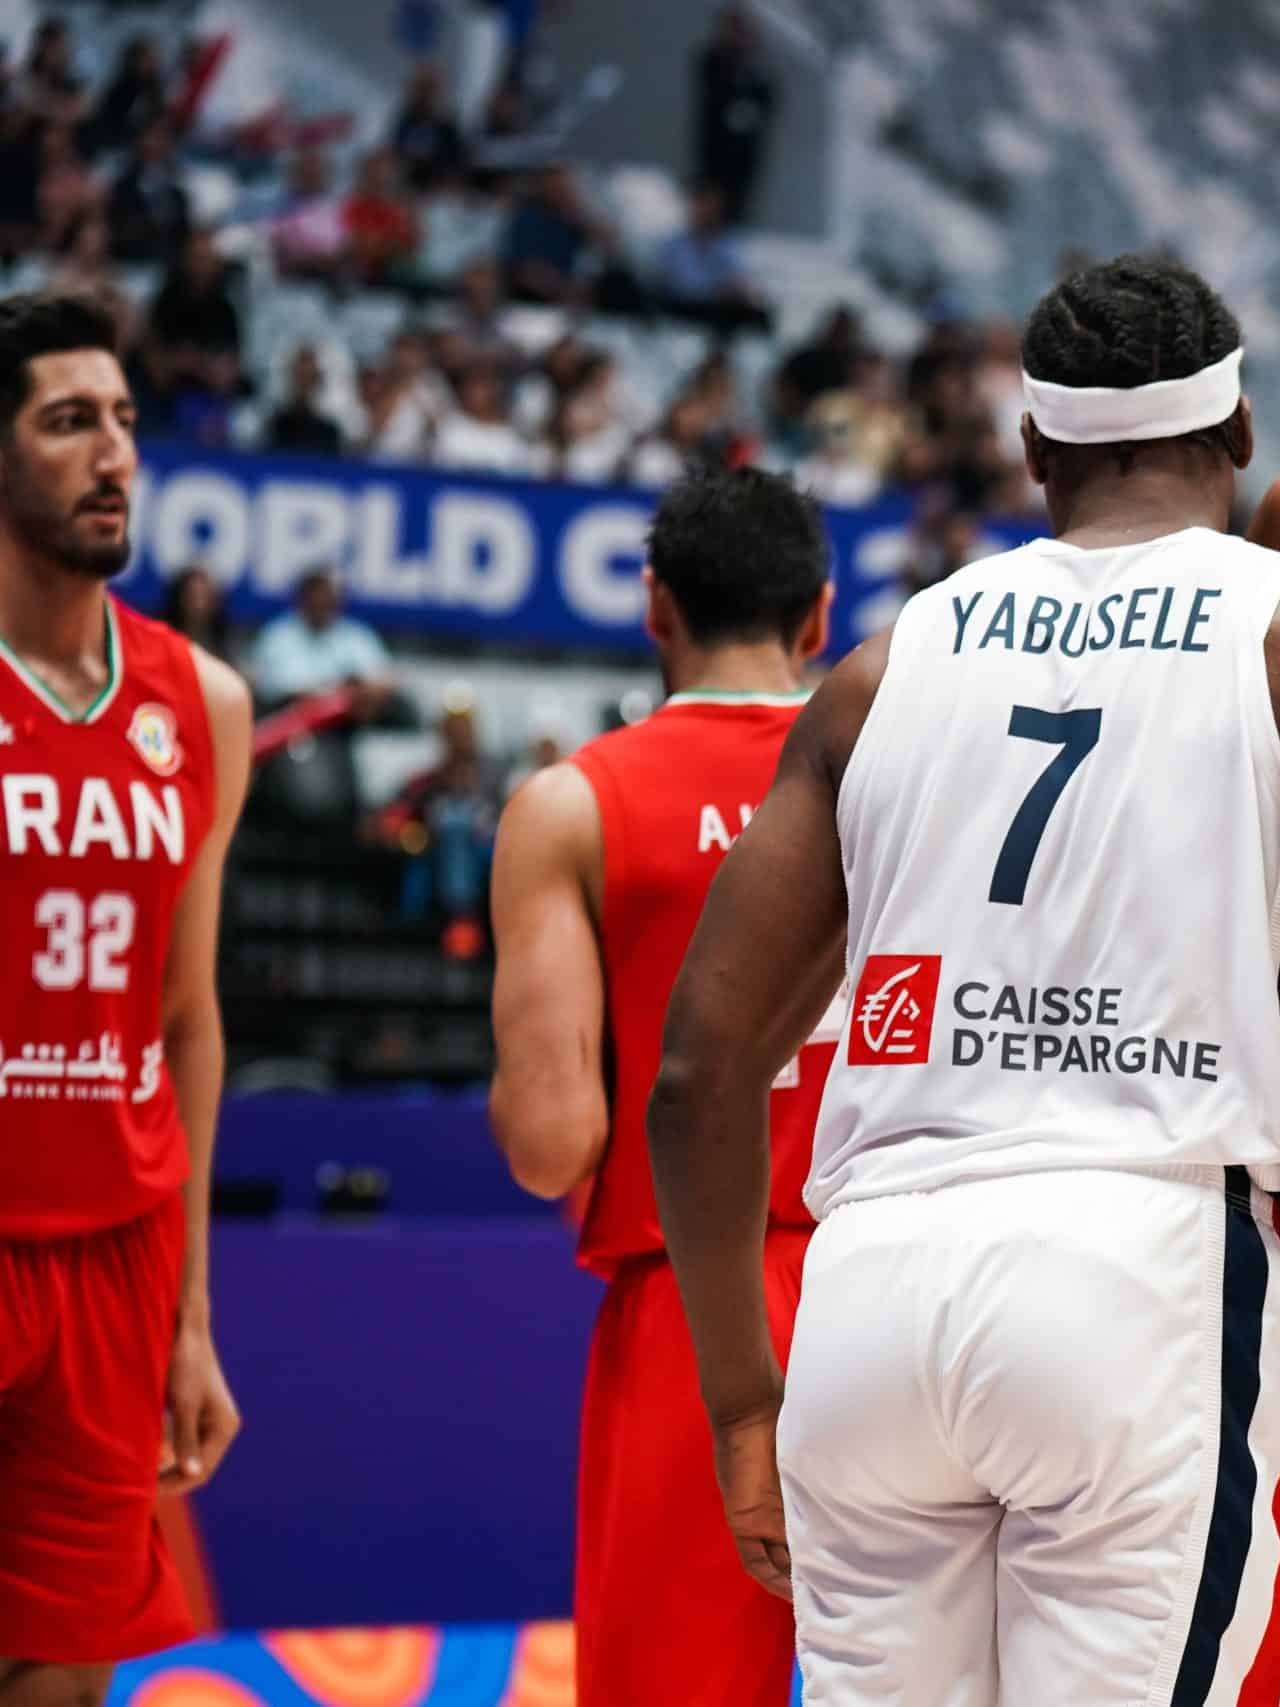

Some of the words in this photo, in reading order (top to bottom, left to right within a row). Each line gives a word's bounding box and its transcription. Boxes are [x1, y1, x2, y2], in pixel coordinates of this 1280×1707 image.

[128, 469, 535, 612] ORLD
[952, 587, 1222, 658] YABUSELE
[2, 773, 185, 865] RAN
[988, 704, 1103, 905] 7
[33, 887, 137, 991] 32
[953, 981, 1122, 1026] CAISSE
[951, 1029, 1222, 1082] D'EPARGNE
